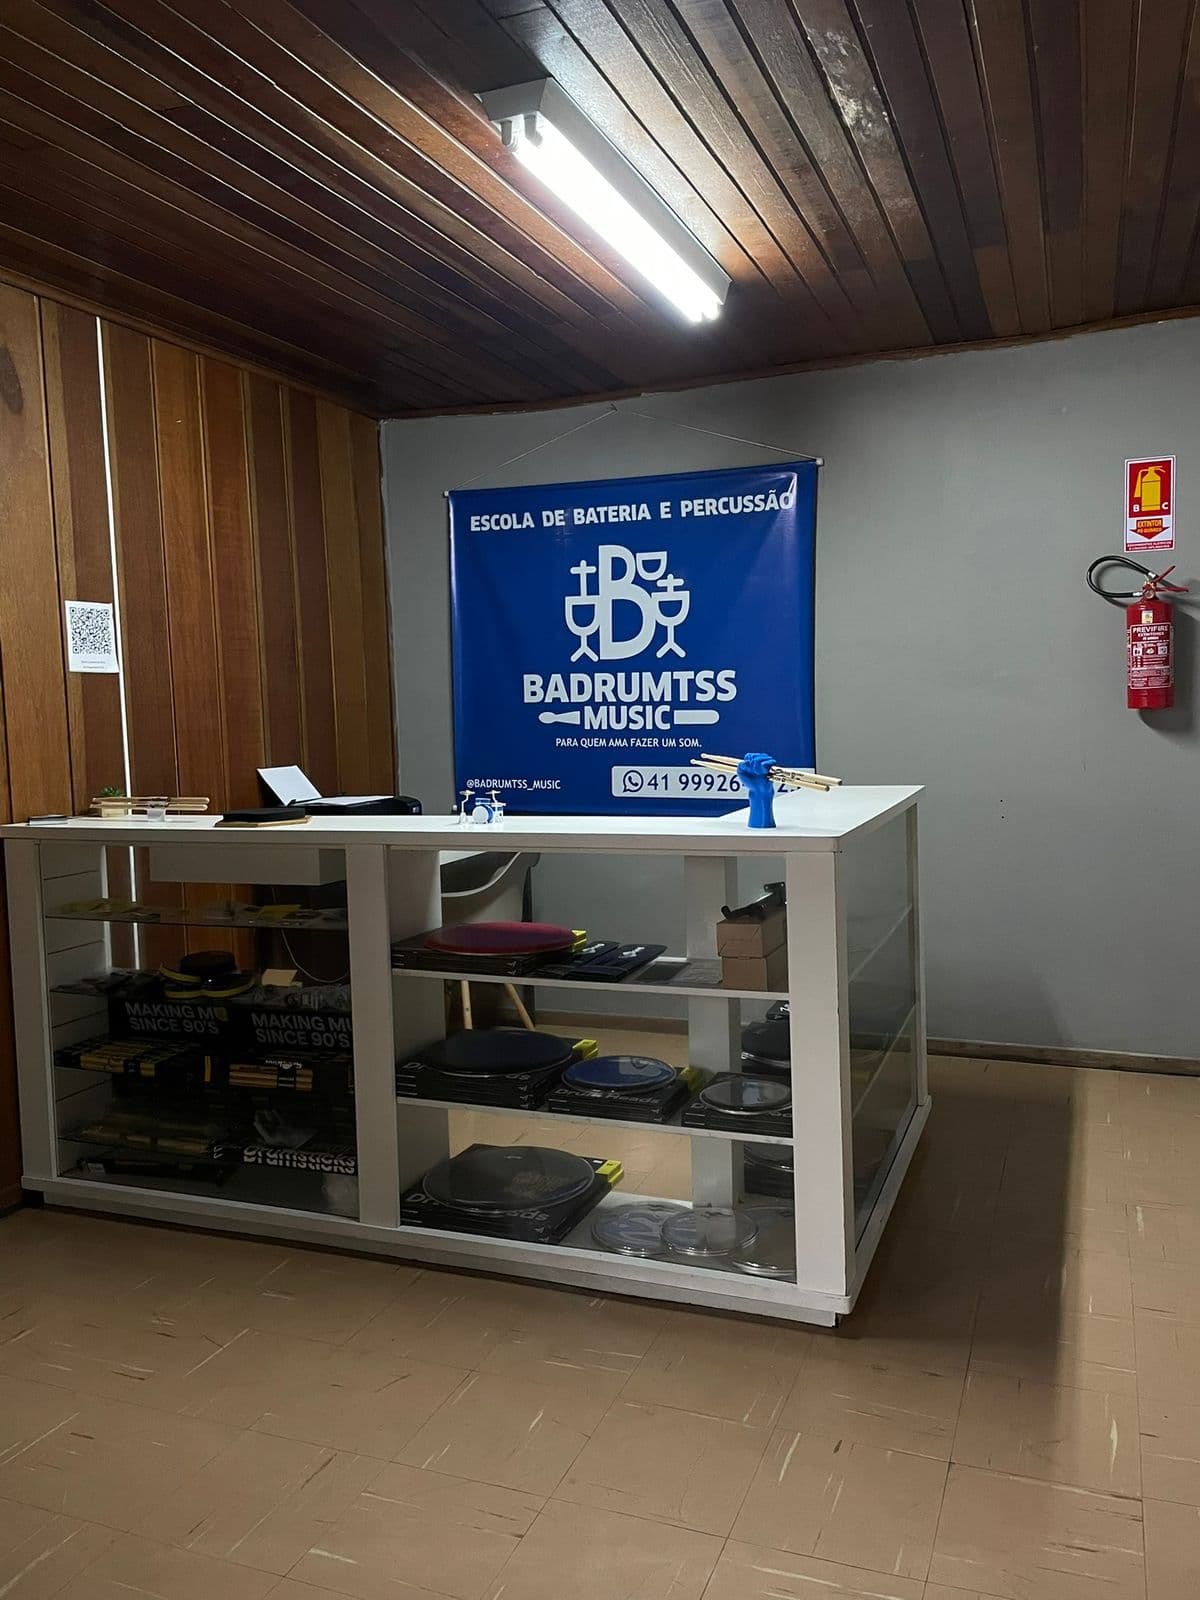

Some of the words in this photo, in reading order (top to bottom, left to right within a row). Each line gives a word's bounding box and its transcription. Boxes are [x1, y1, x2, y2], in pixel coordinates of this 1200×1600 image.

[470, 512, 535, 532] ESCOLA
[542, 509, 566, 527] DE
[573, 503, 652, 525] BATERIA
[660, 501, 672, 519] E
[680, 489, 794, 518] PERCUSSÃO
[1133, 504, 1140, 512] B
[1161, 502, 1168, 510] C
[523, 669, 737, 703] BADRUMTSS
[584, 705, 671, 730] MUSIC
[555, 738, 579, 747] PARA
[580, 738, 607, 748] QUEM
[608, 738, 629, 747] AMA
[630, 738, 659, 747] FAZER
[661, 738, 677, 747] UM
[678, 738, 702, 748] SOM.
[466, 778, 561, 791] @BADRUMTSS_MUSIC
[648, 773, 669, 790] 41
[125, 1002, 195, 1018] MAKING
[129, 1018, 180, 1033] SINCE
[182, 1020, 219, 1035] 90'S
[252, 1013, 326, 1031] MAKING
[256, 1029, 310, 1046] SINCE
[311, 1032, 351, 1049] 90'S
